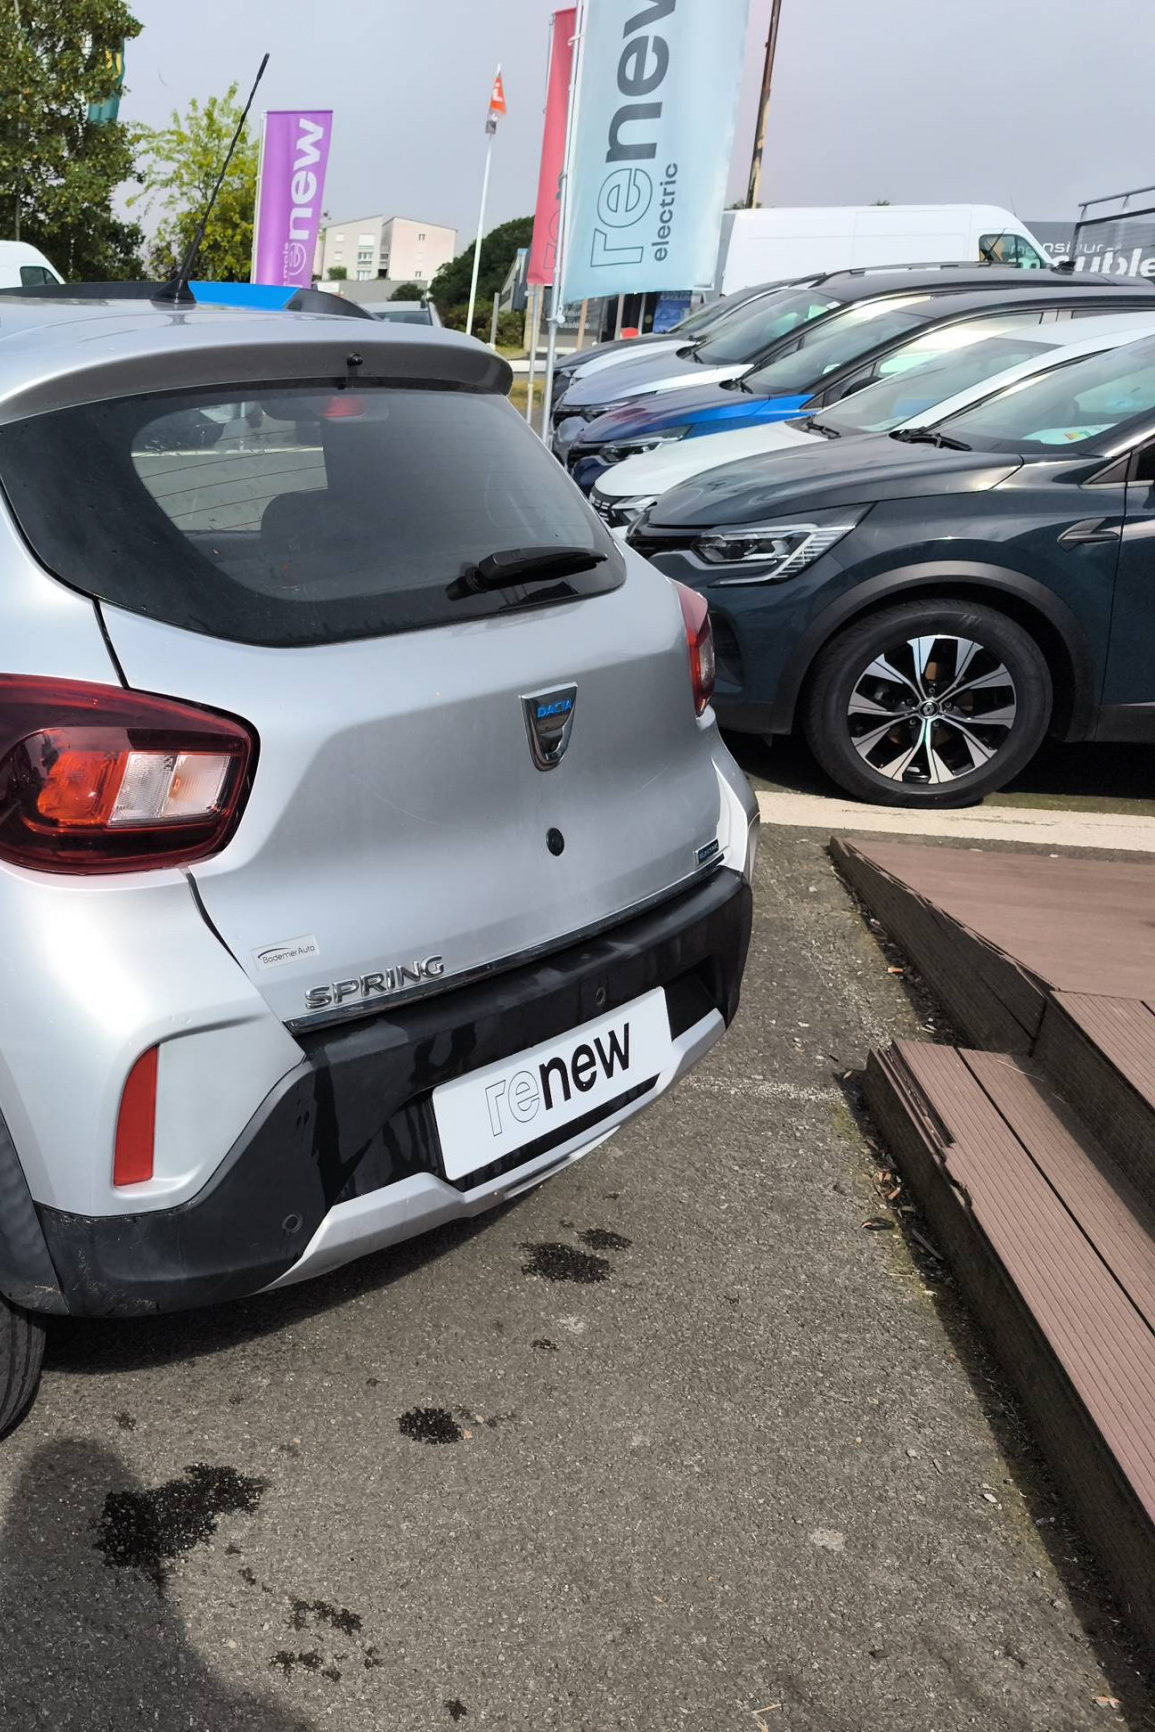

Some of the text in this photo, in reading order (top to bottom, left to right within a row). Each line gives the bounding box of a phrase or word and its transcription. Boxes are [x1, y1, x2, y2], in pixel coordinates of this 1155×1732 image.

[651, 163, 678, 261] electric
[537, 699, 572, 719] DACIA
[305, 954, 445, 1009] SPRING
[485, 1022, 630, 1137] renew
